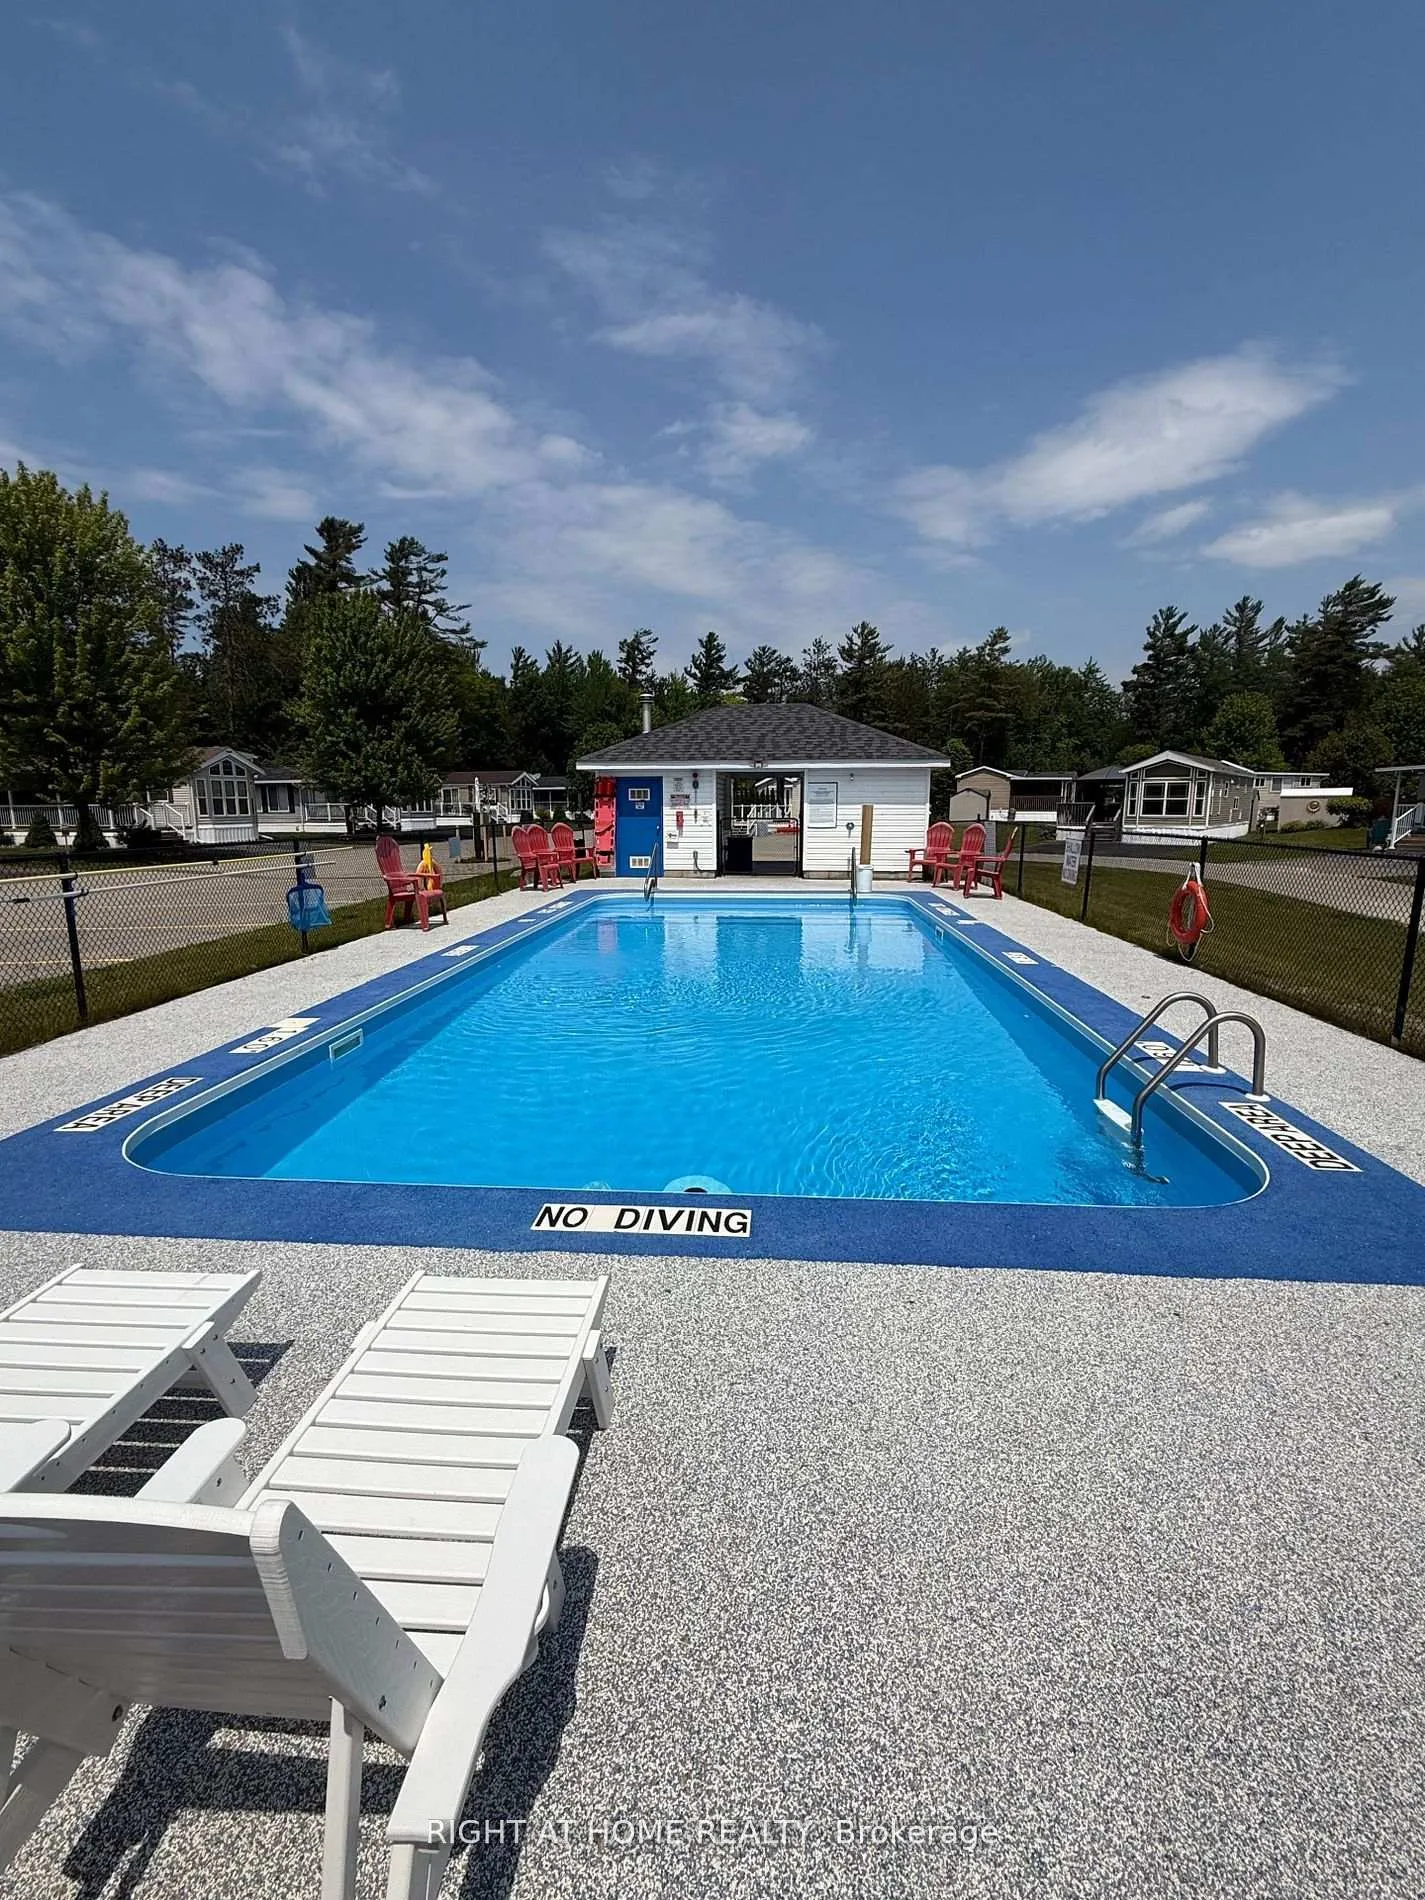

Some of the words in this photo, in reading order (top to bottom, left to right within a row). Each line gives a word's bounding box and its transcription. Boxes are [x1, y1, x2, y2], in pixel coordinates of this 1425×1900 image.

[134, 1078, 198, 1102] DEEP
[61, 1103, 142, 1130] AREA
[1227, 1104, 1297, 1133] AREA
[1269, 1134, 1355, 1170] DEEP
[535, 1206, 588, 1228] NO
[614, 1207, 748, 1234] DIVING
